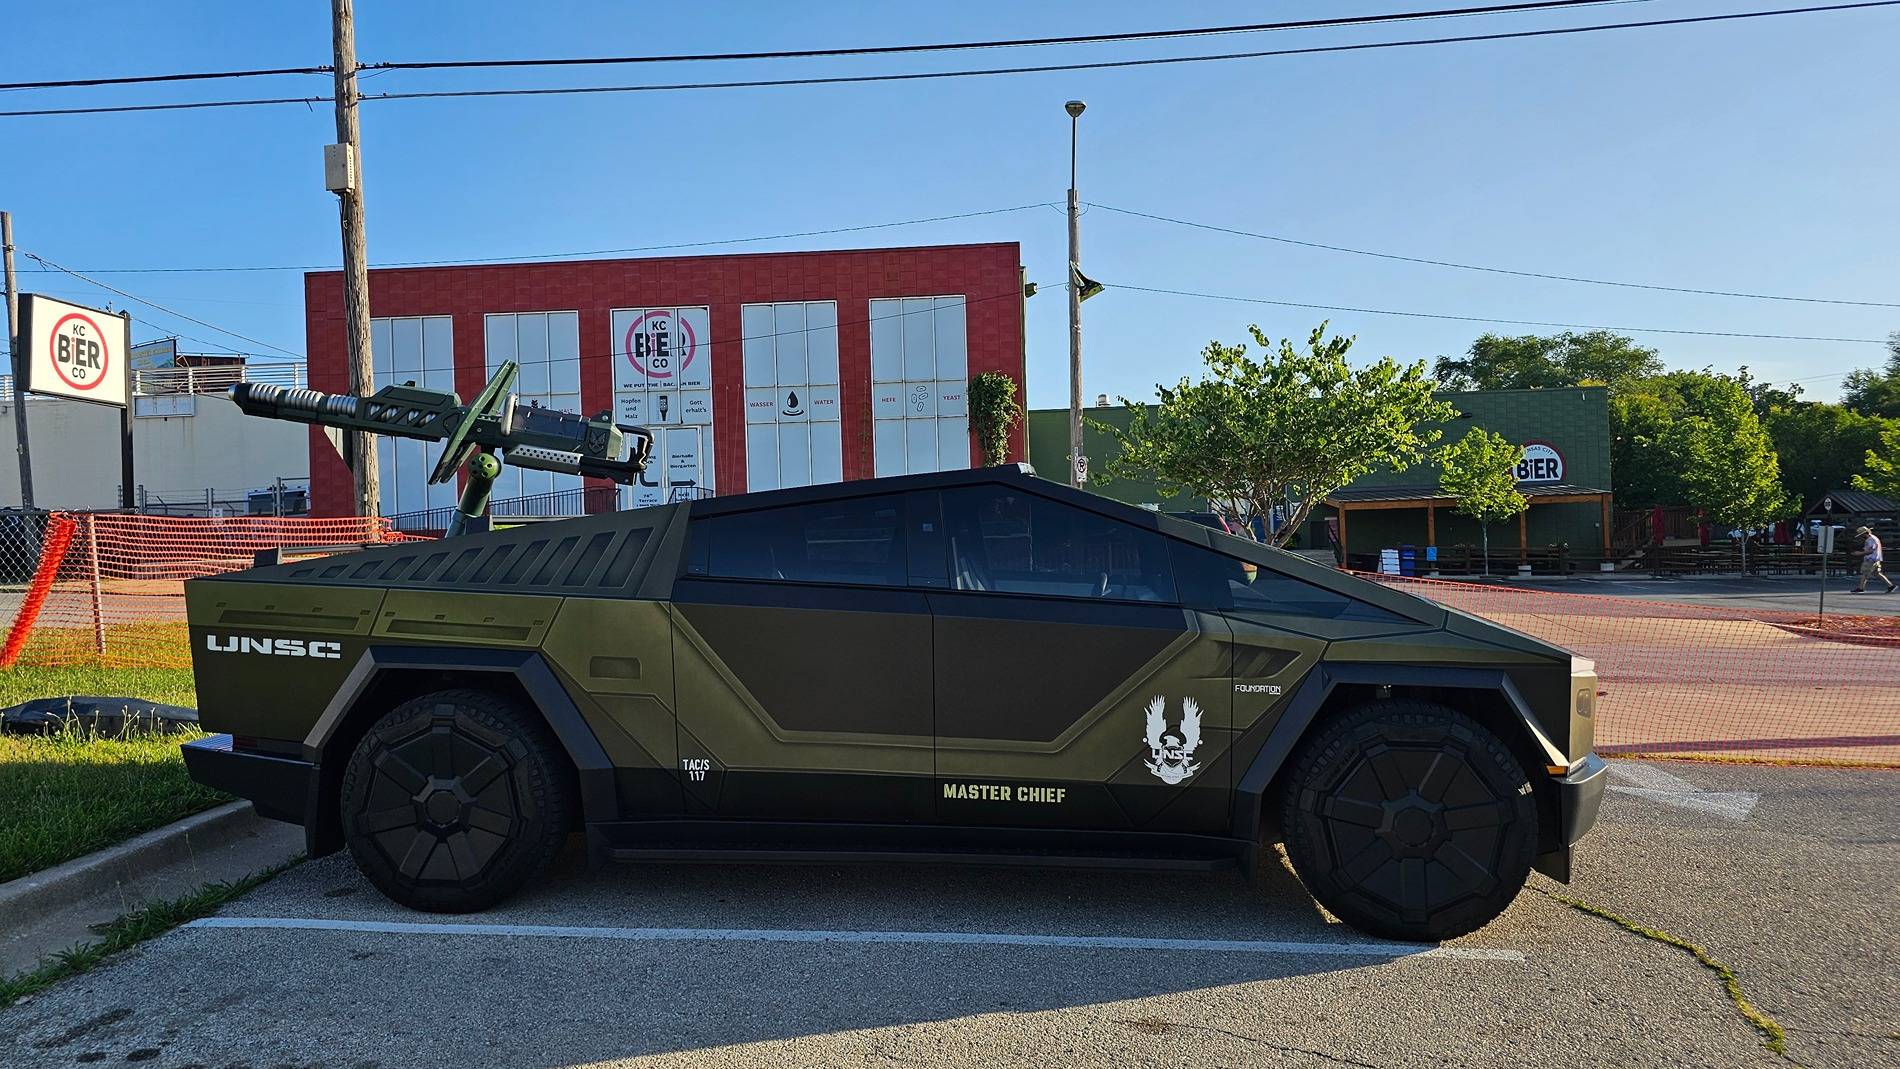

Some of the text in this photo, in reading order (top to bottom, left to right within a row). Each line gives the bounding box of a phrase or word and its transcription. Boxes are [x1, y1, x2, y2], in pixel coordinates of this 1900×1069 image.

[73, 324, 86, 336] KC
[652, 320, 667, 331] KC
[653, 359, 668, 368] CO
[72, 367, 86, 379] CO
[207, 635, 341, 659] UNSC
[1234, 684, 1282, 694] FOUNDATION
[1152, 748, 1194, 761] UNSC
[682, 758, 710, 771] TAC/S
[689, 770, 706, 782] 117
[943, 783, 1066, 803] MASTER CHIEF
